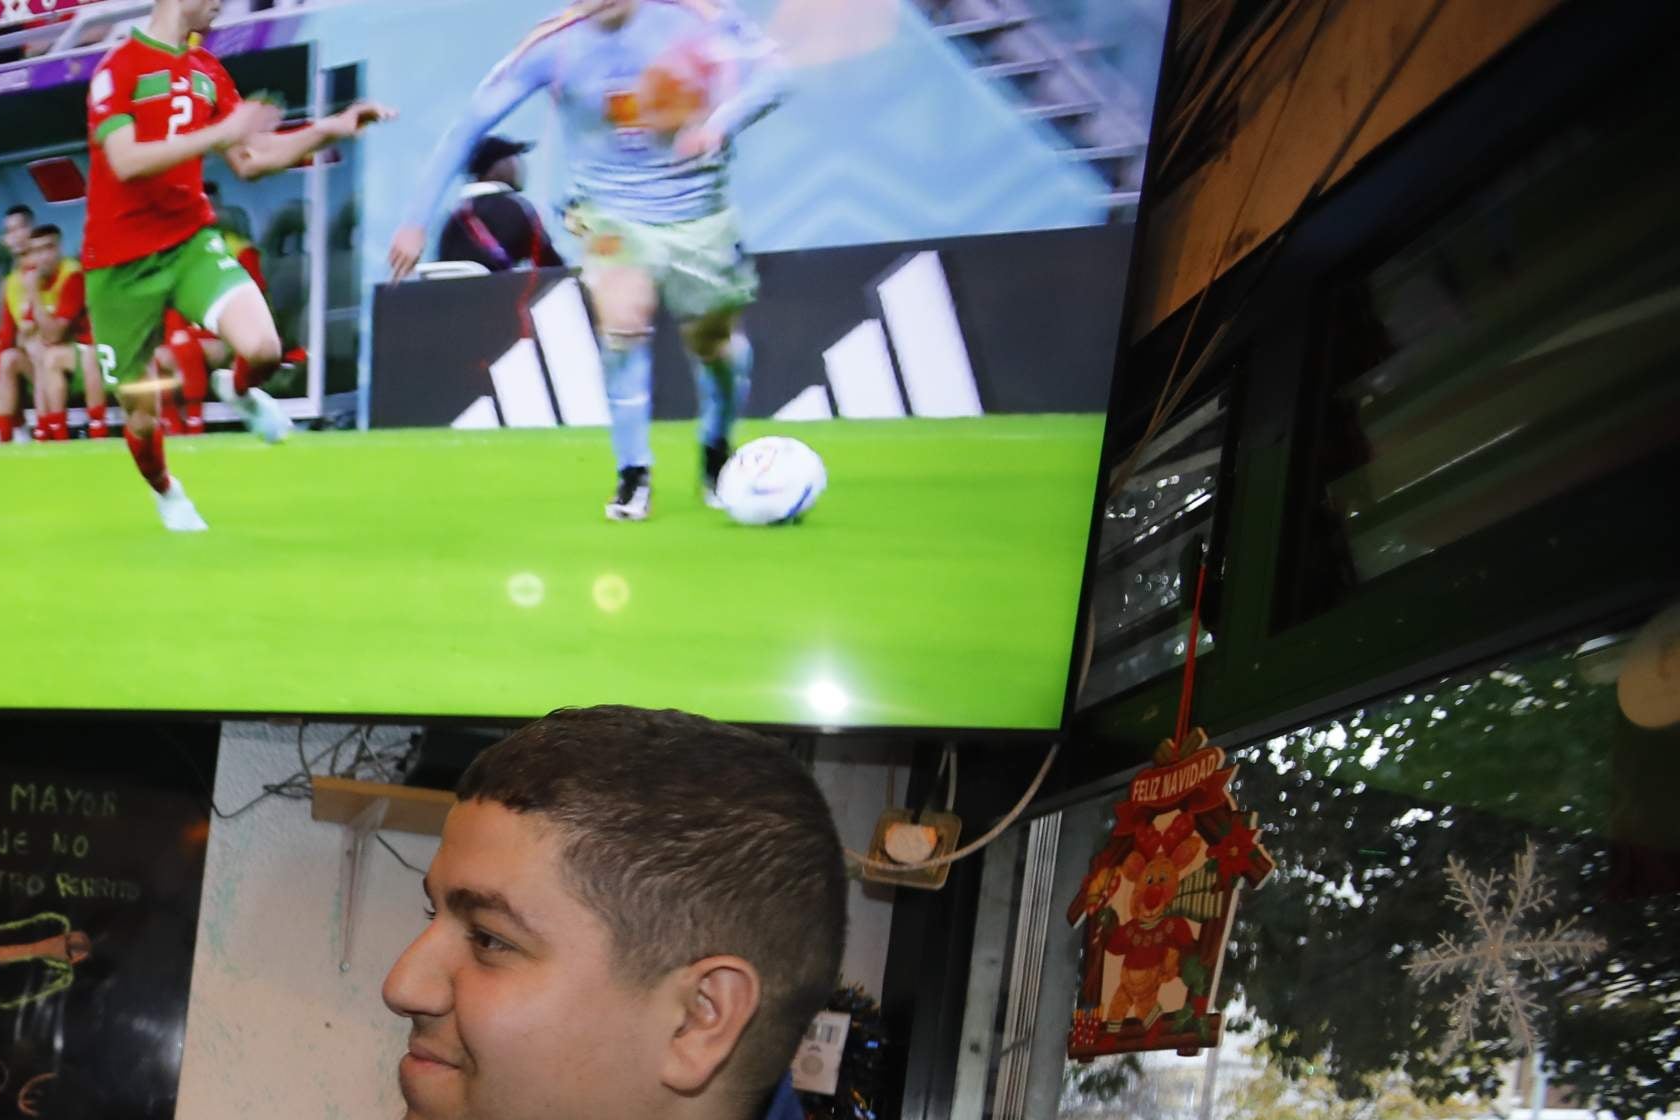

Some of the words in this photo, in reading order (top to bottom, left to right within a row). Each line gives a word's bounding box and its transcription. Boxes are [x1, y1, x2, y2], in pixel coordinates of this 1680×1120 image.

[1132, 776, 1162, 801] FELIZ
[1162, 754, 1217, 798] NAVIDAD
[52, 832, 90, 858] NO
